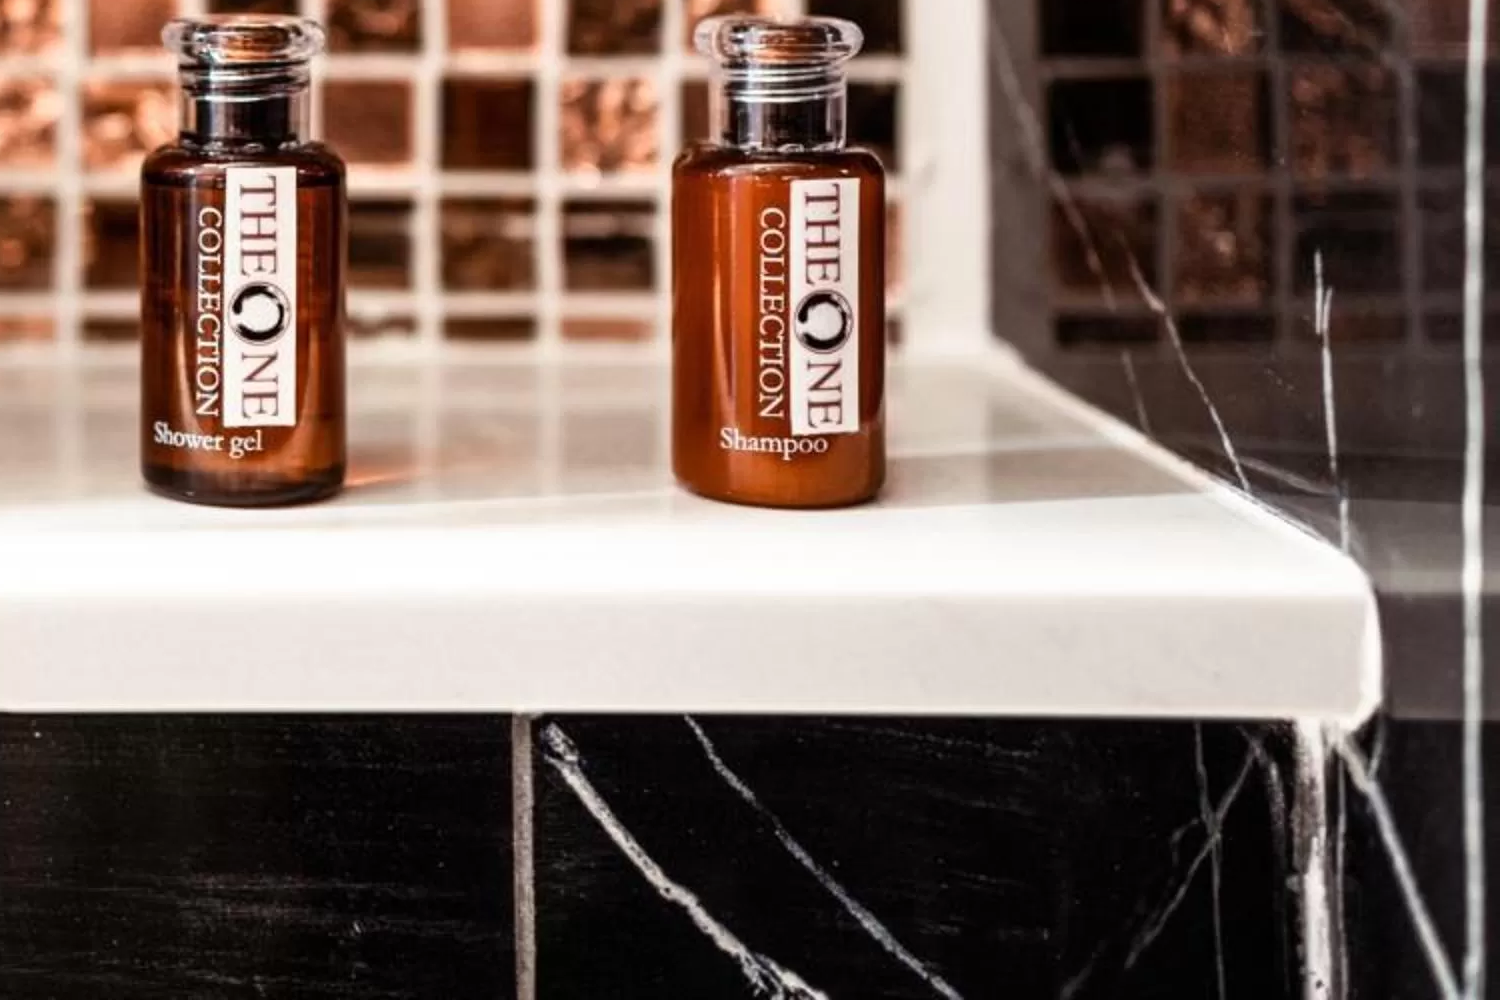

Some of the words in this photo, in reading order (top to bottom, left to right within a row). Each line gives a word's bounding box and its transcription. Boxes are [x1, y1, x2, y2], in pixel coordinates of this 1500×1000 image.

[240, 175, 277, 276] THE
[804, 183, 841, 285] THE
[196, 207, 222, 416] COLLECTION
[758, 207, 787, 419] COLLECTION
[154, 421, 225, 451] Shower
[229, 430, 263, 458] gel
[719, 426, 828, 461] Shampoo
